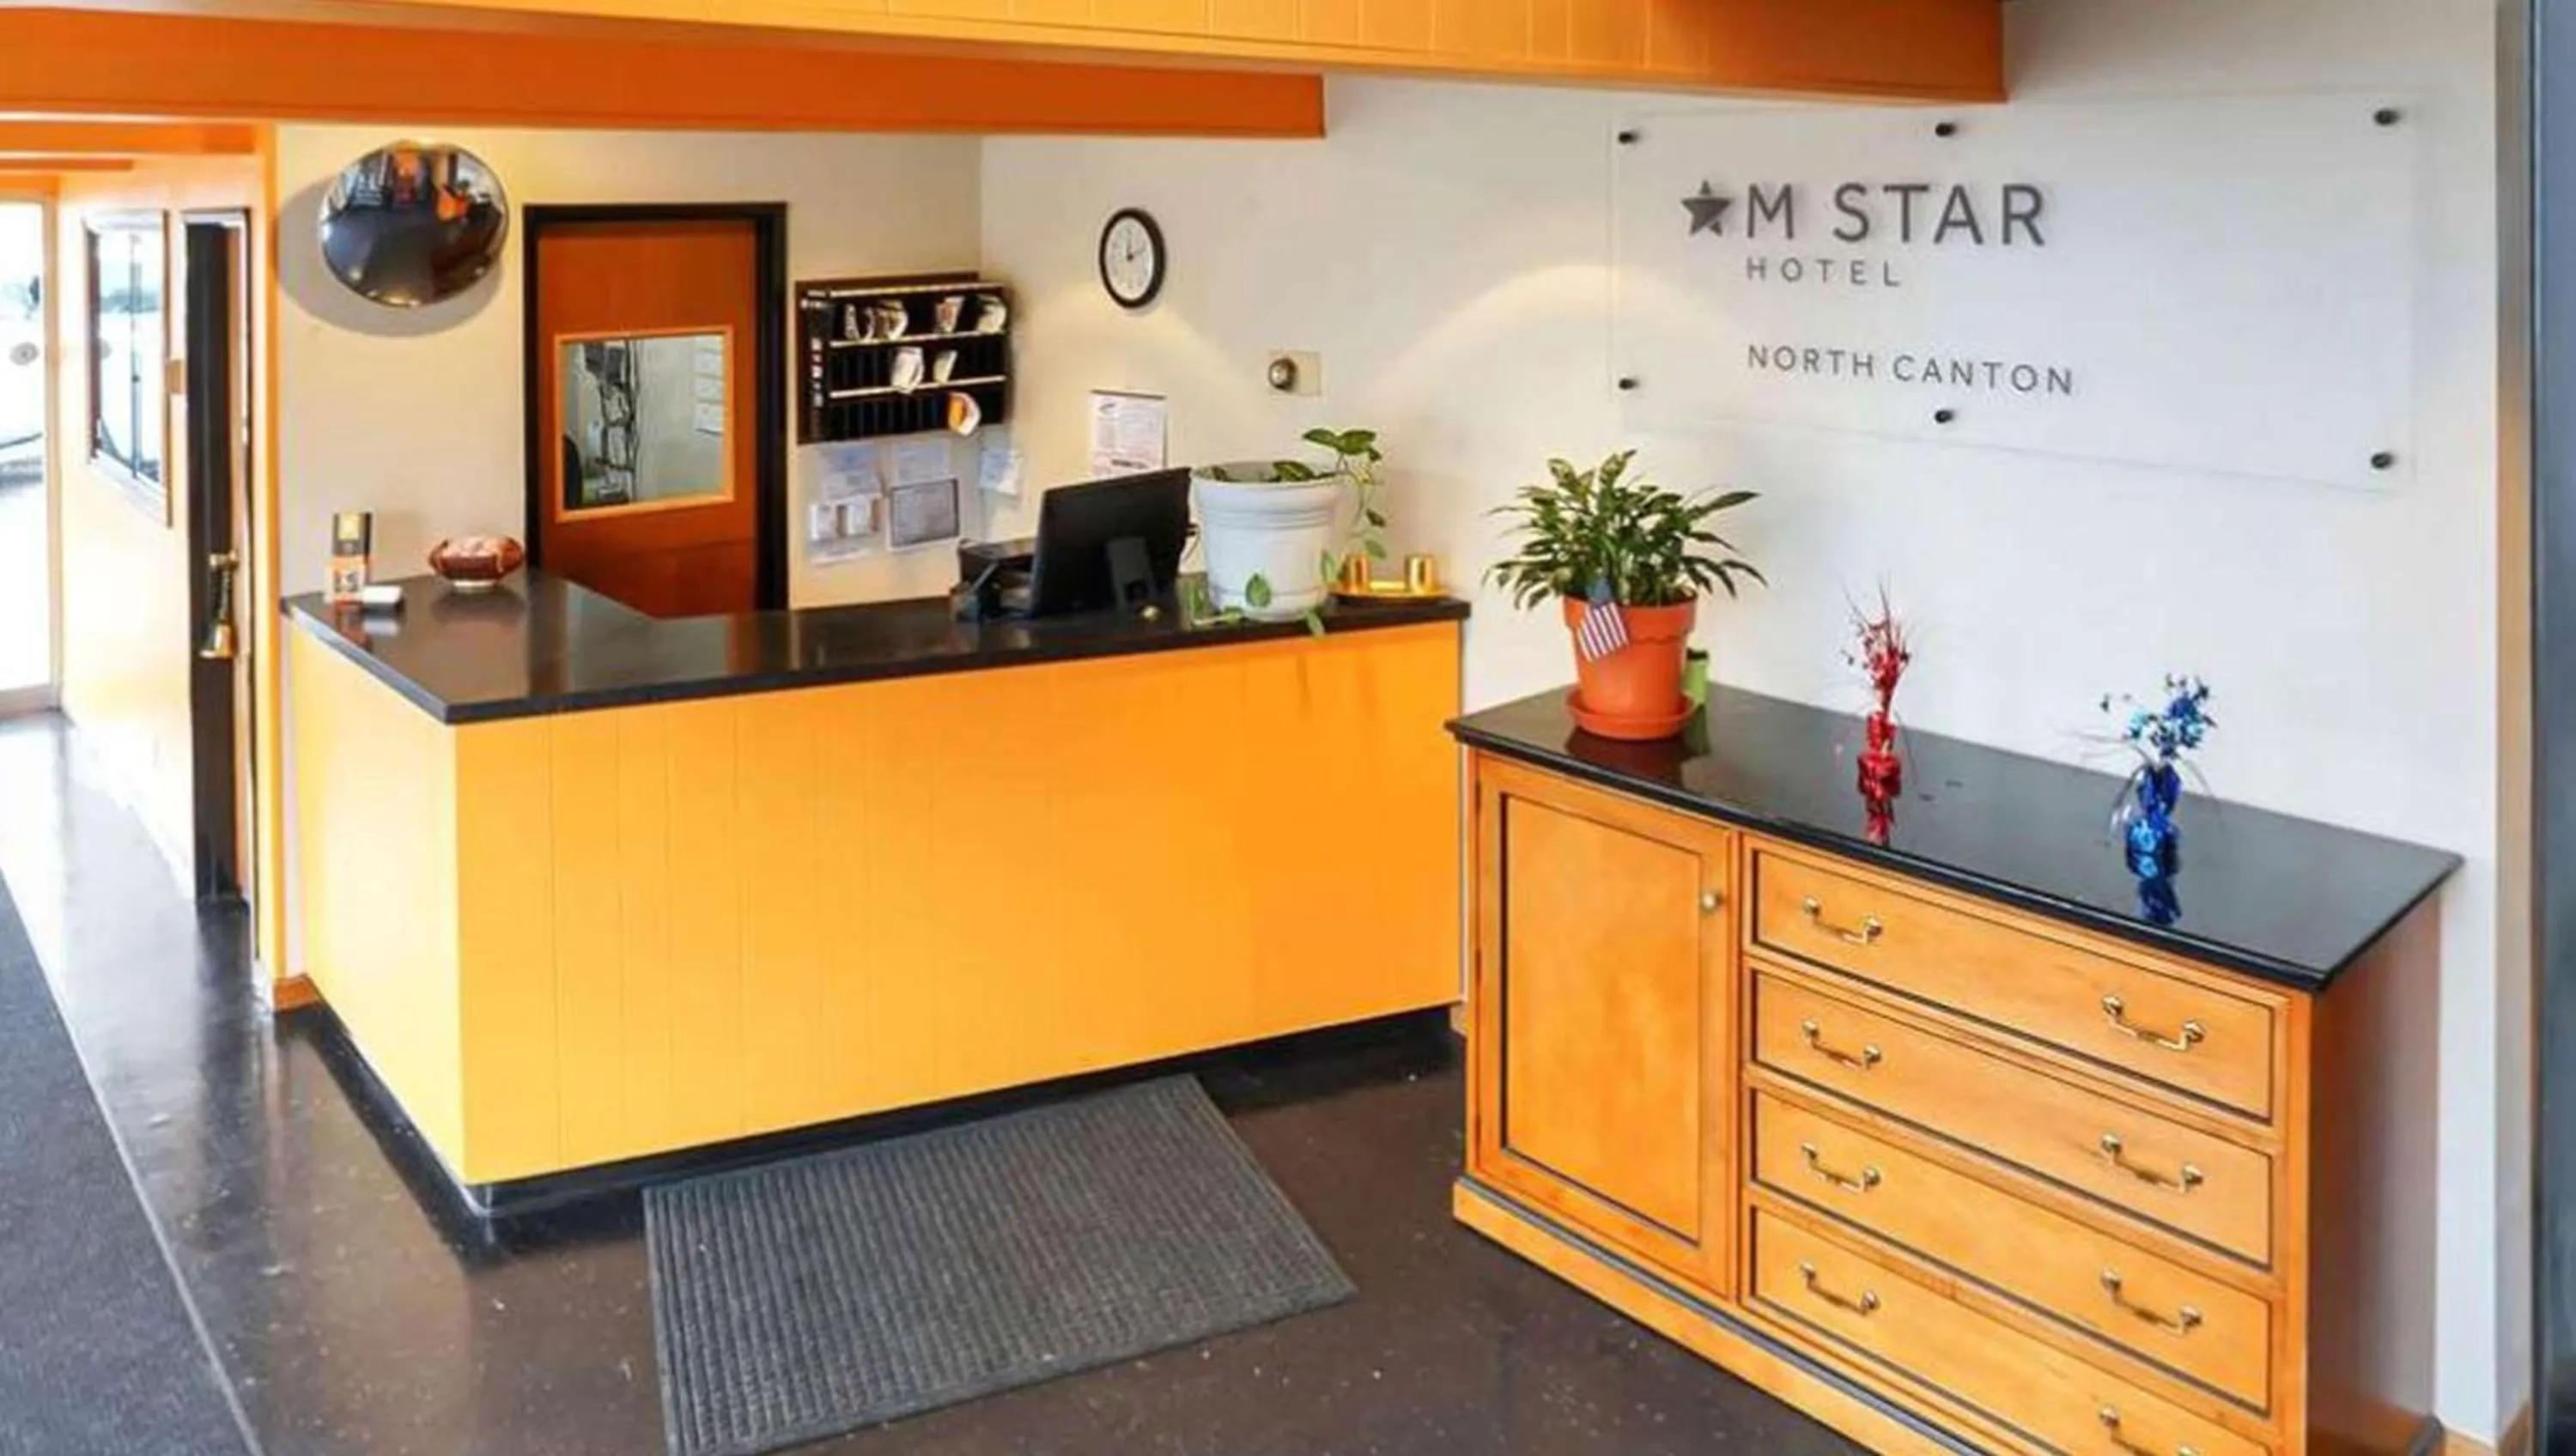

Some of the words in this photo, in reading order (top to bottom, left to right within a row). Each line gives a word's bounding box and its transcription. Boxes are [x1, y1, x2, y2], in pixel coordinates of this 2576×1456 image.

[1747, 183, 1795, 240] M
[1832, 181, 2046, 246] STAR
[1746, 257, 1900, 287] HOTEL
[1748, 344, 1874, 378] NORTH
[1893, 355, 2072, 395] CANTON
